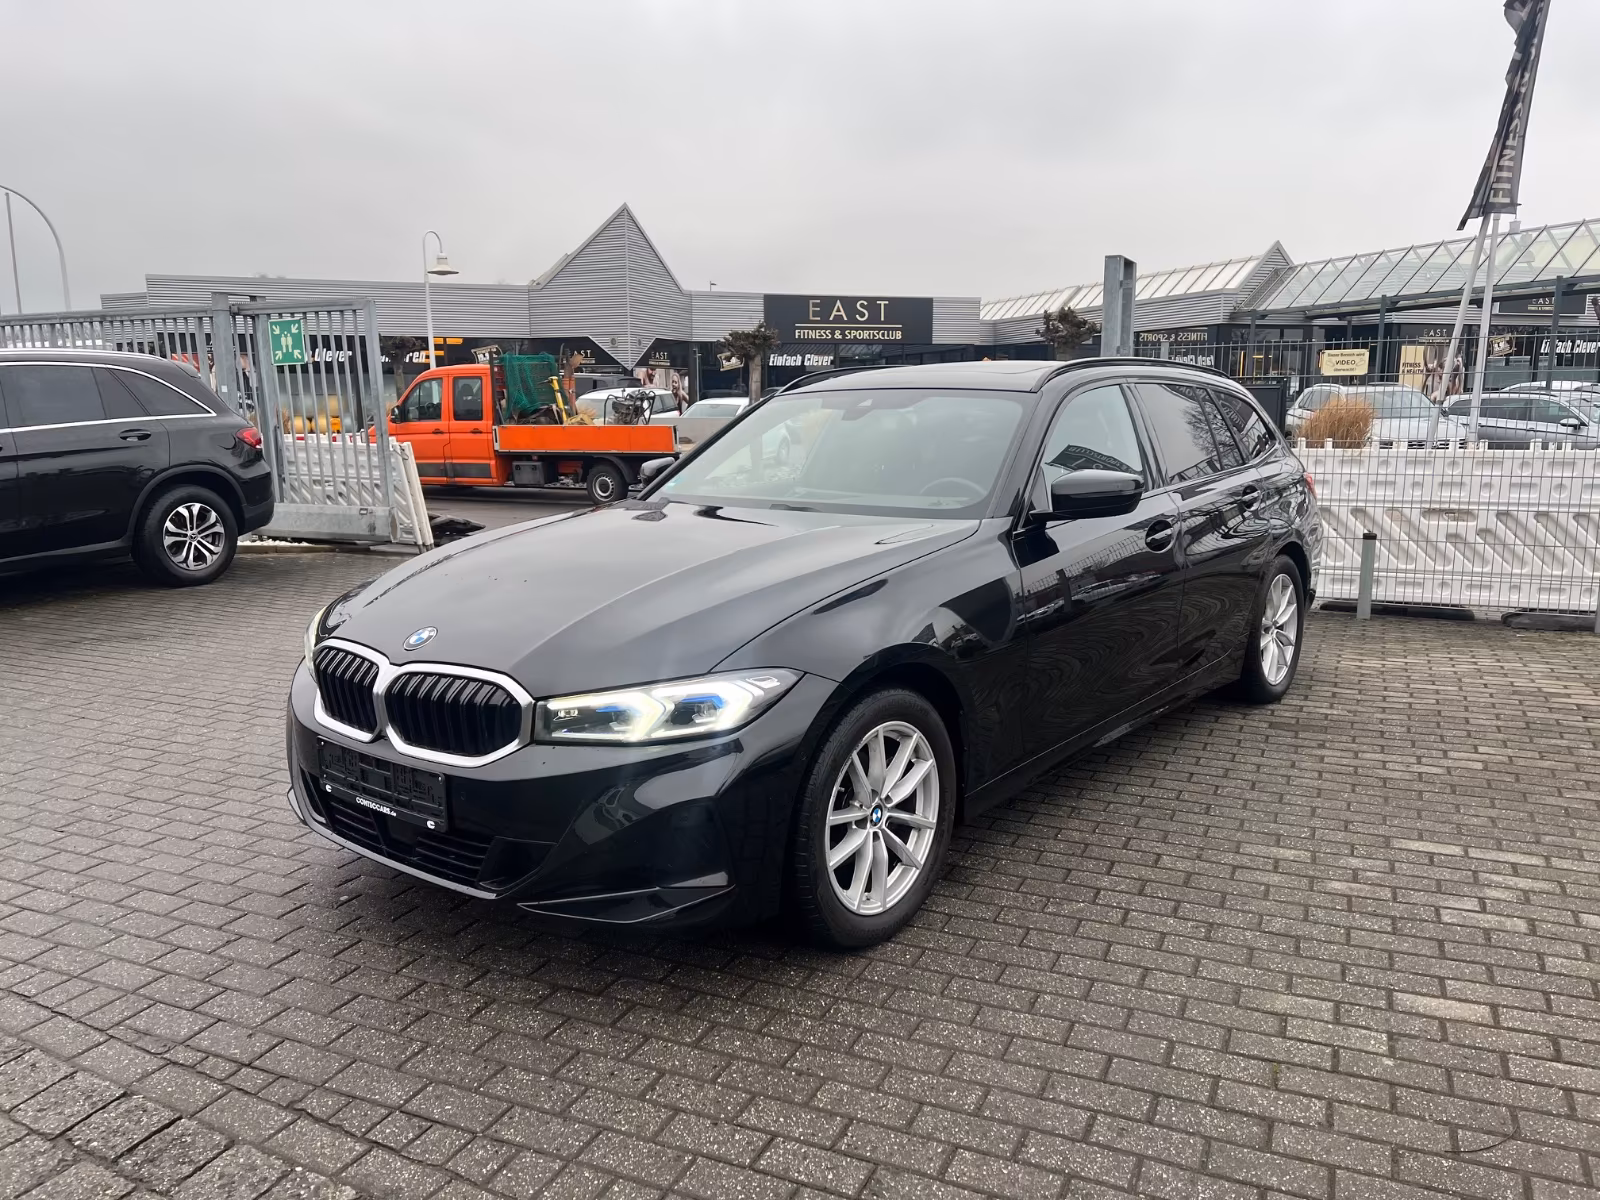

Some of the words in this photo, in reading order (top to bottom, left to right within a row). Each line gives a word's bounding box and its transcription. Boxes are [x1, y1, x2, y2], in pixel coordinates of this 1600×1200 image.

[808, 299, 889, 322] EAST
[795, 329, 832, 339] FITNESS
[833, 329, 843, 339] &
[844, 330, 902, 340] SPORTSCLUB
[1423, 329, 1447, 337] EAST
[651, 352, 668, 360] EAST
[769, 353, 802, 367] Einfach
[804, 354, 834, 367] Clever
